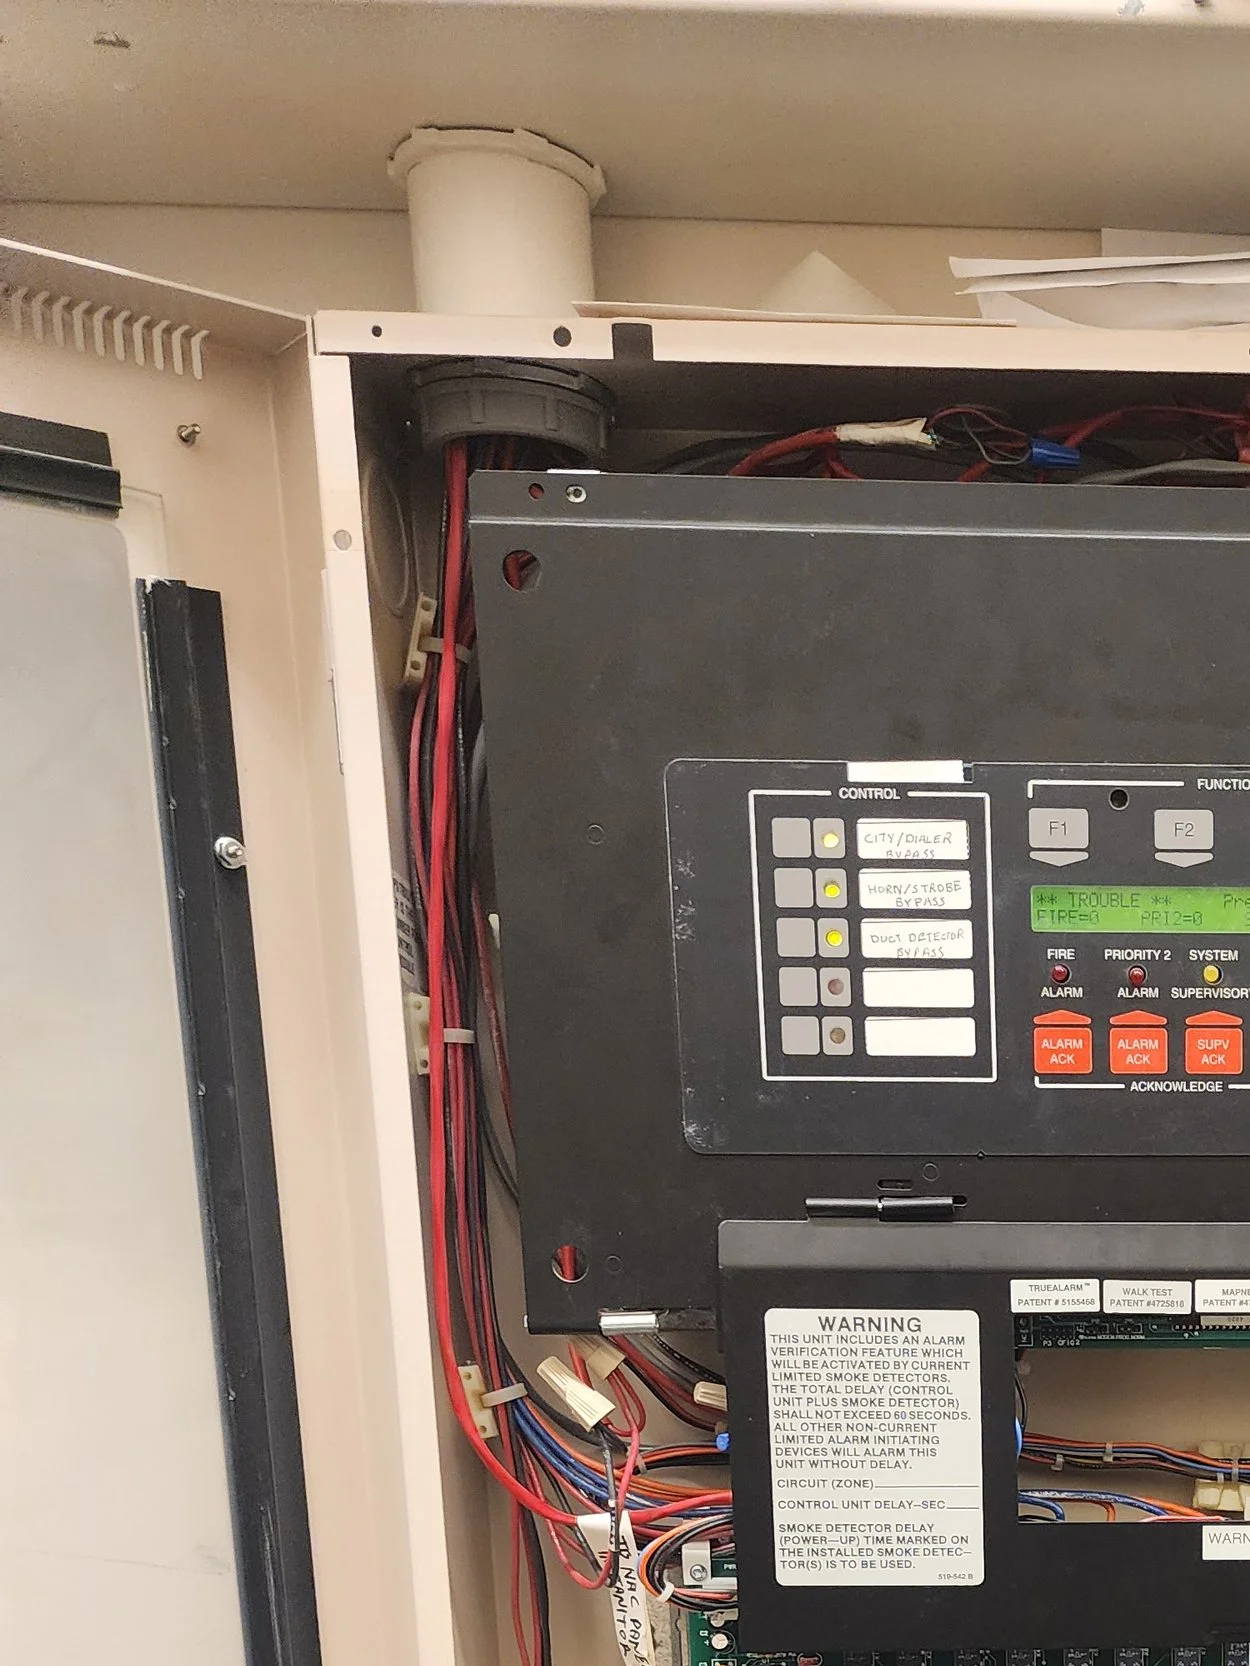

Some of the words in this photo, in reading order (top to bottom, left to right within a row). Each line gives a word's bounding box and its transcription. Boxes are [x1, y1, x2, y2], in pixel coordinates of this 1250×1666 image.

[839, 787, 900, 800] CONTROL
[1049, 821, 1067, 836] F1
[1174, 822, 1194, 837] F2
[895, 897, 946, 907] BYPASS
[1068, 893, 1140, 908] TROUBLE
[870, 934, 901, 943] DUCT
[1047, 949, 1075, 960] FIRE
[1104, 949, 1162, 960] PRIORITY
[1164, 950, 1171, 960] 2
[1189, 950, 1239, 961] SYSTEM
[1041, 987, 1083, 998] ALARM
[1117, 987, 1159, 998] ALARM
[1041, 1038, 1083, 1049] ALARM
[1117, 1039, 1159, 1050] ALARM
[1197, 1039, 1229, 1050] SUPV
[1050, 1054, 1075, 1064] ACK
[1126, 1054, 1150, 1065] ACK
[1201, 1054, 1226, 1065] ACK
[1130, 1081, 1223, 1092] ACKNOWLEDGE
[1151, 1288, 1172, 1296] TEST
[1110, 1299, 1145, 1307] PATENT
[818, 1316, 922, 1332] WARNING
[770, 1335, 799, 1344] THIS
[802, 1335, 833, 1344] UNIT
[836, 1335, 899, 1345] INCLUDES
[902, 1336, 920, 1345] AN
[923, 1336, 965, 1345] ALARM
[771, 1347, 858, 1357] VERIFICATION
[862, 1348, 918, 1357] FEATURE
[922, 1348, 963, 1358] WHICH
[772, 1360, 801, 1369] WILL
[803, 1360, 818, 1369] BE
[821, 1360, 890, 1370] ACTIVATED
[893, 1361, 908, 1370] BY
[911, 1361, 970, 1371] CURRENT
[772, 1372, 821, 1382] LIMITED
[826, 1373, 869, 1382] SMOKE
[873, 1373, 951, 1383] DETECTORS.
[777, 1479, 828, 1488] CIRCUIT
[831, 1479, 874, 1490] (ZONE)
[780, 1560, 822, 1571] TOR(S)
[826, 1560, 837, 1569] IS
[840, 1560, 857, 1569] TO
[861, 1560, 877, 1569] BE
[880, 1560, 916, 1569] USED.
[620, 1566, 641, 1607] NAC
